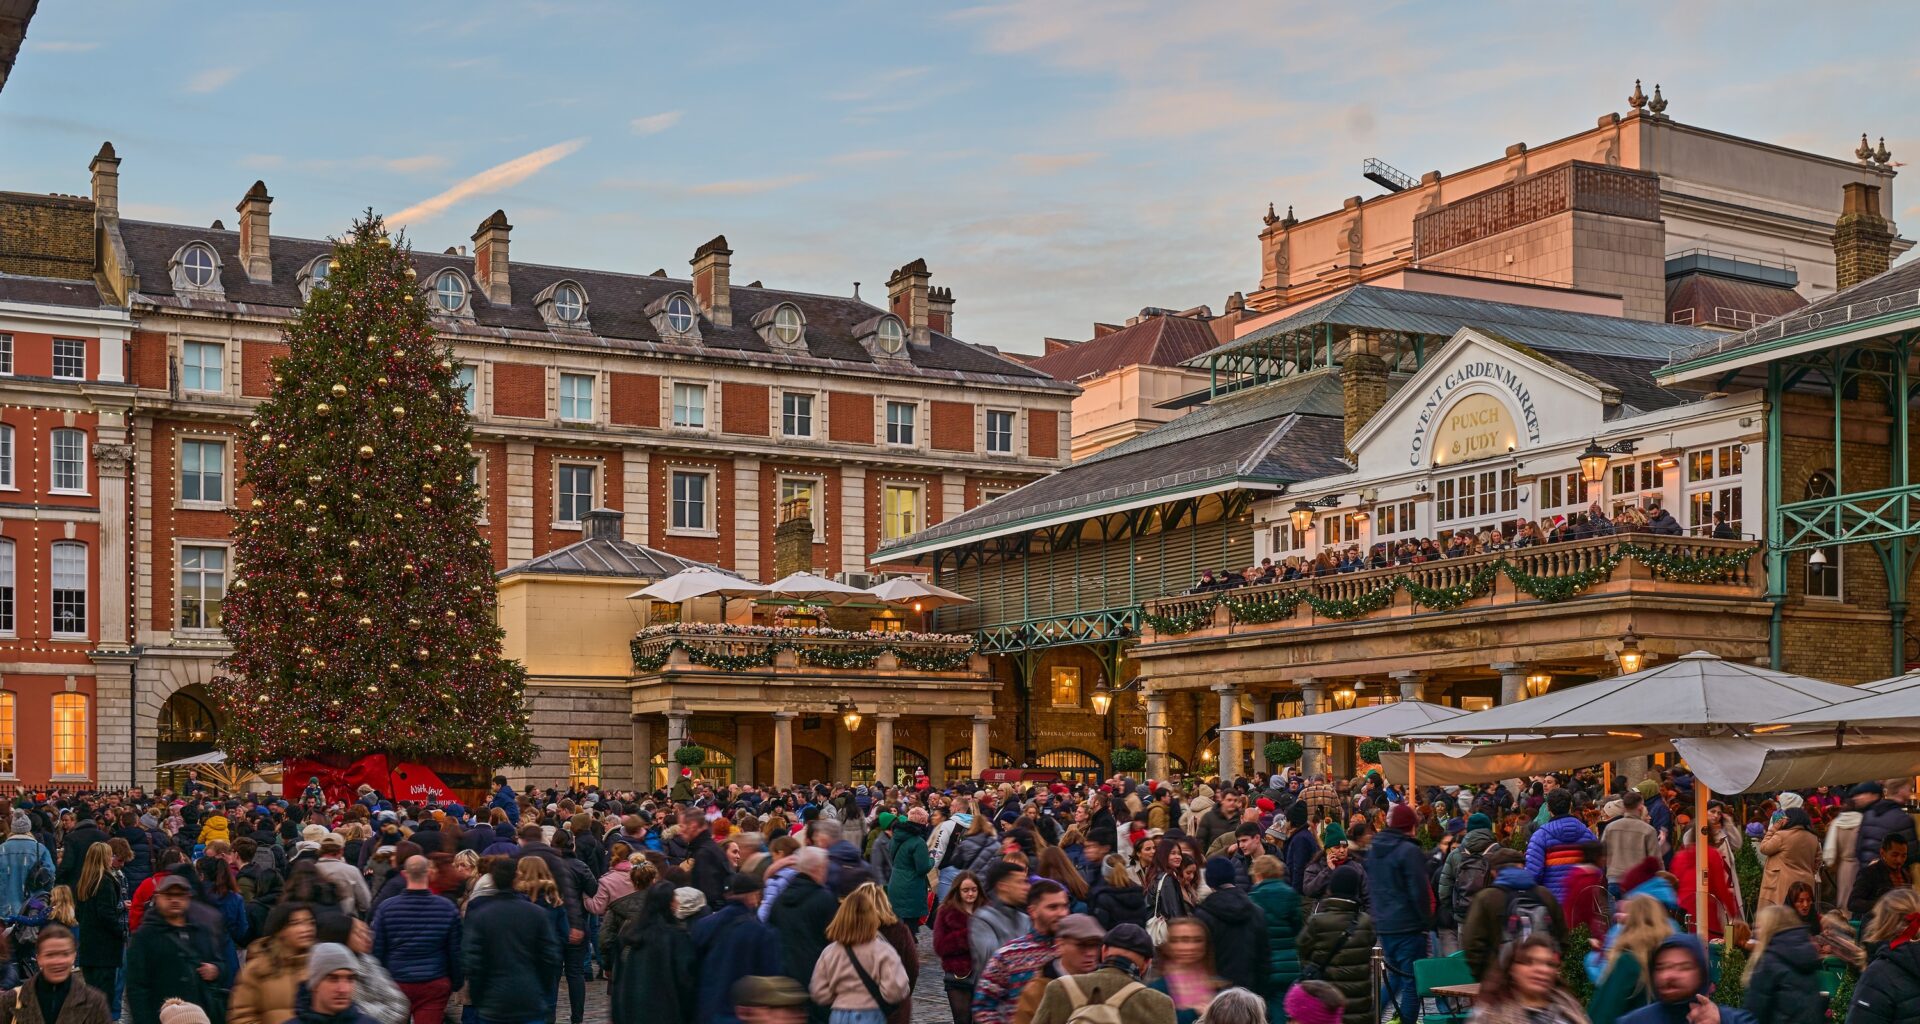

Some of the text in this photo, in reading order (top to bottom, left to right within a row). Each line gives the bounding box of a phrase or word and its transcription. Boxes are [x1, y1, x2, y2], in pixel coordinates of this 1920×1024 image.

[1410, 362, 1540, 466] COVENT GARDEN MARKET
[1451, 407, 1499, 431] PUNCH
[1452, 431, 1500, 456] & JUDY
[870, 729, 910, 737] GIVA
